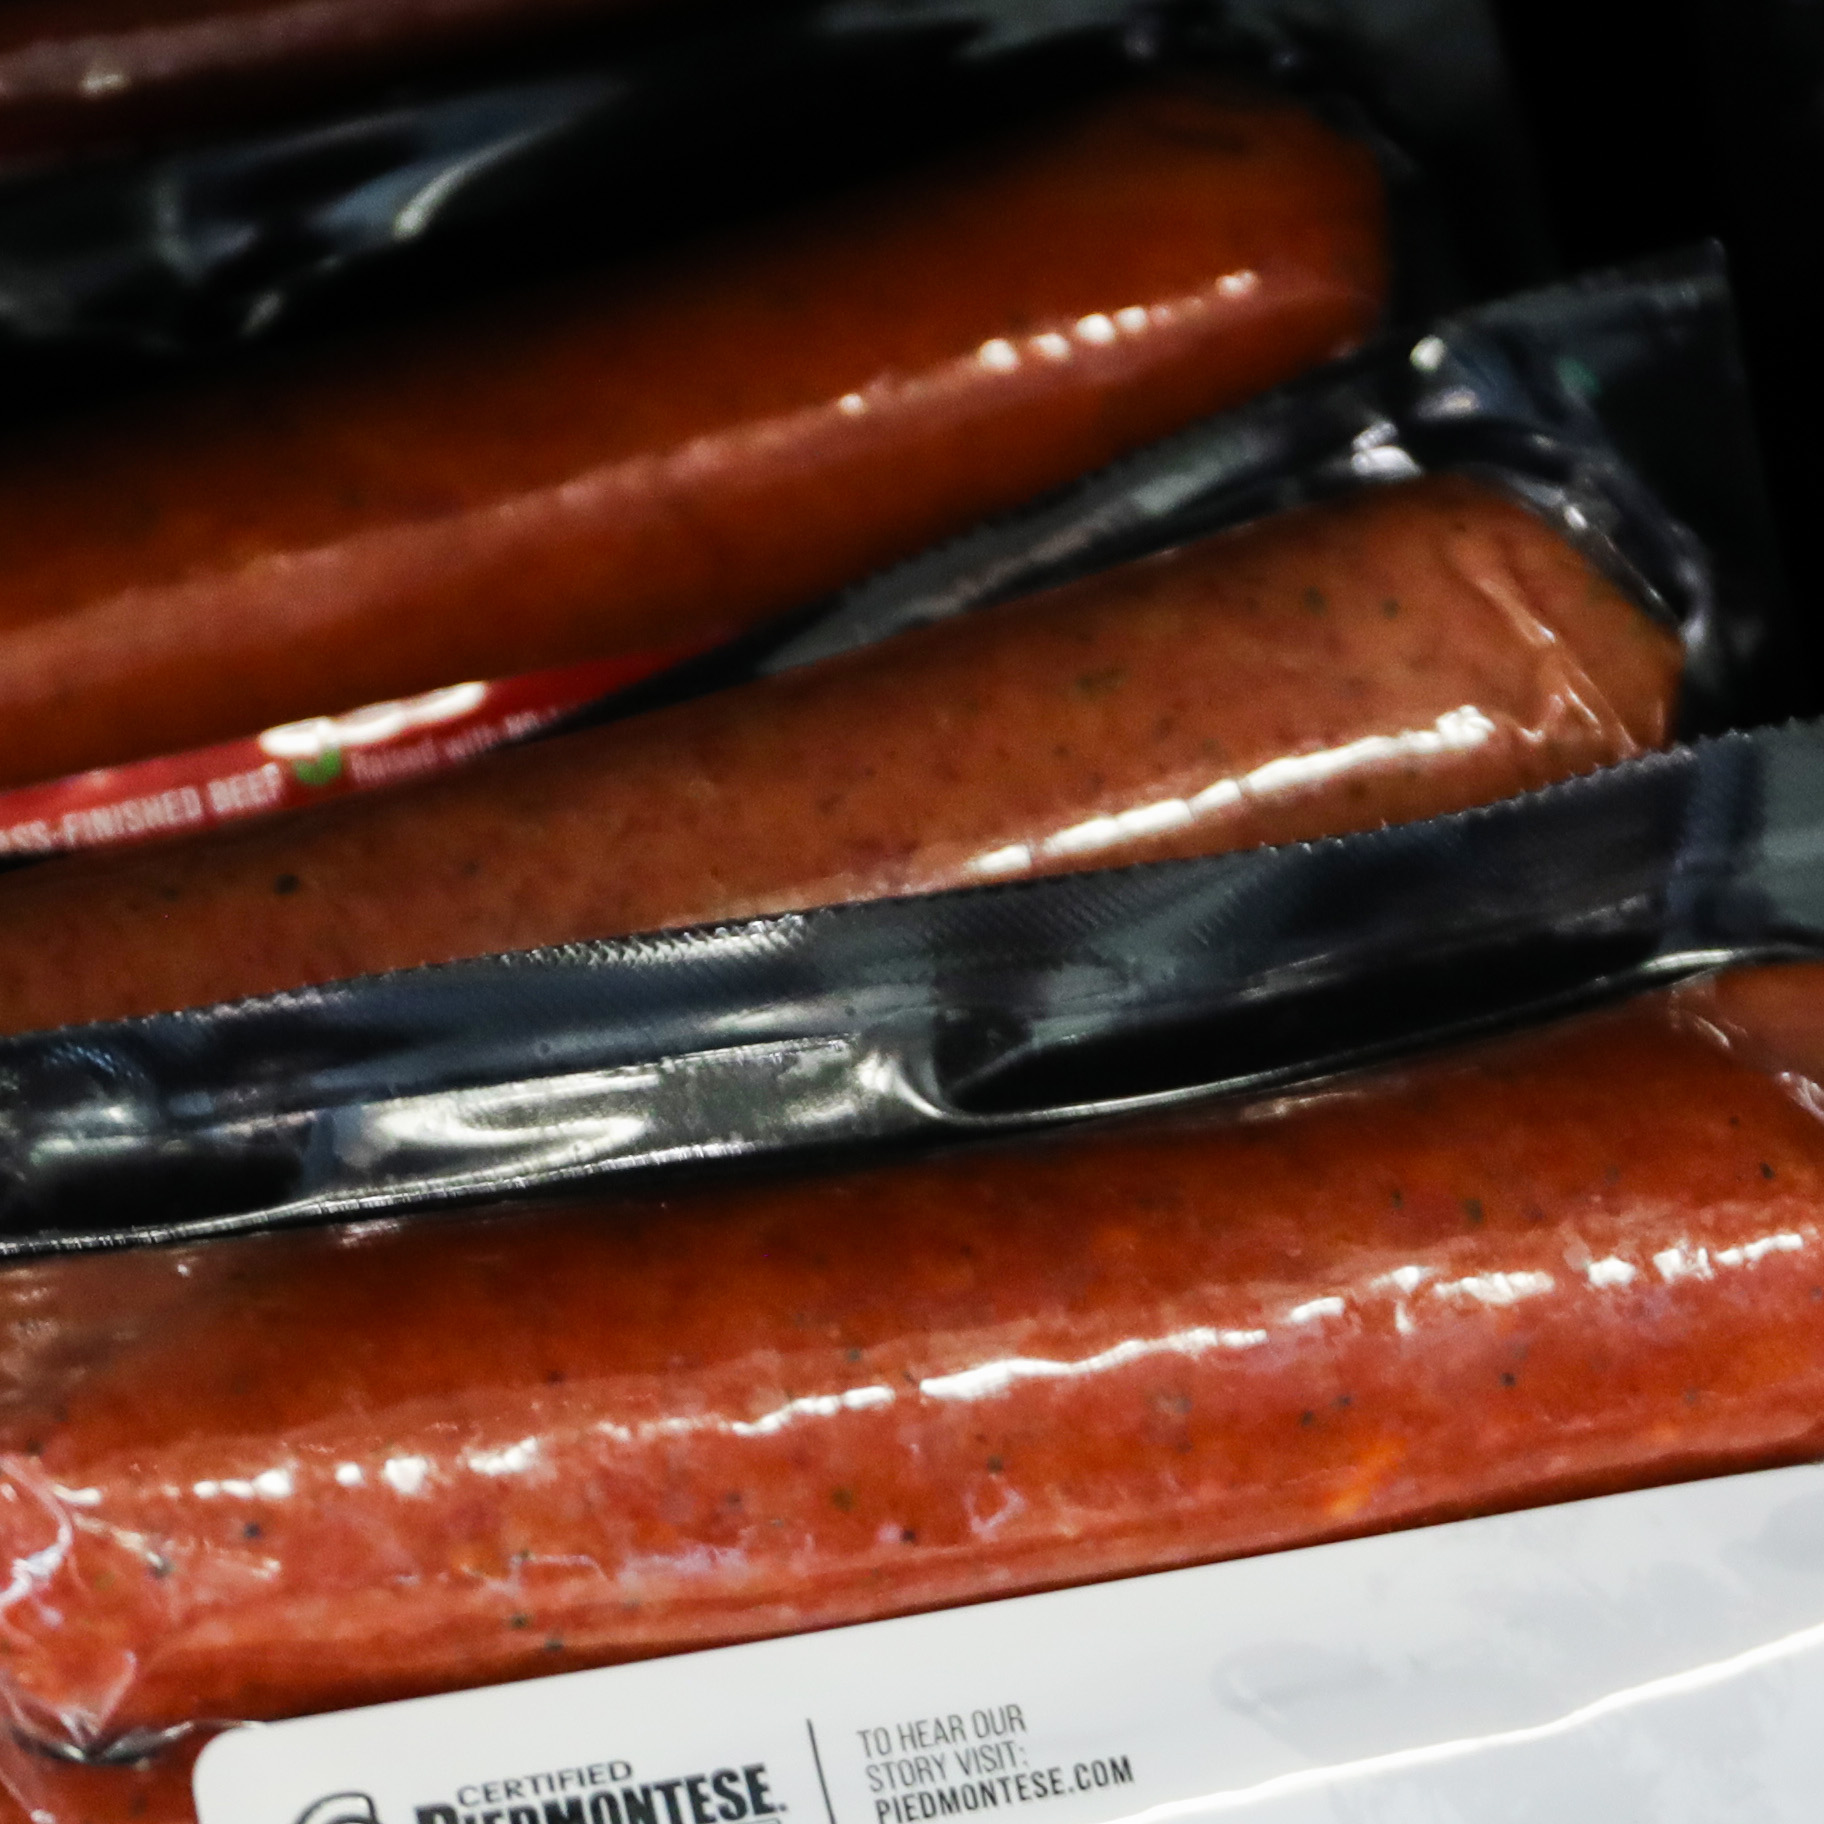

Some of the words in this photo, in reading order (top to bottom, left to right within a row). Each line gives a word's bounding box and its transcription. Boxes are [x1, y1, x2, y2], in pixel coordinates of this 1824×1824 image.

[857, 1725, 893, 1760] TO
[896, 1713, 968, 1753] HEAR
[971, 1702, 1028, 1741] OUR
[456, 1759, 633, 1808] CERTIFIED
[865, 1752, 948, 1795] STORY
[951, 1738, 1030, 1777] VISIT:
